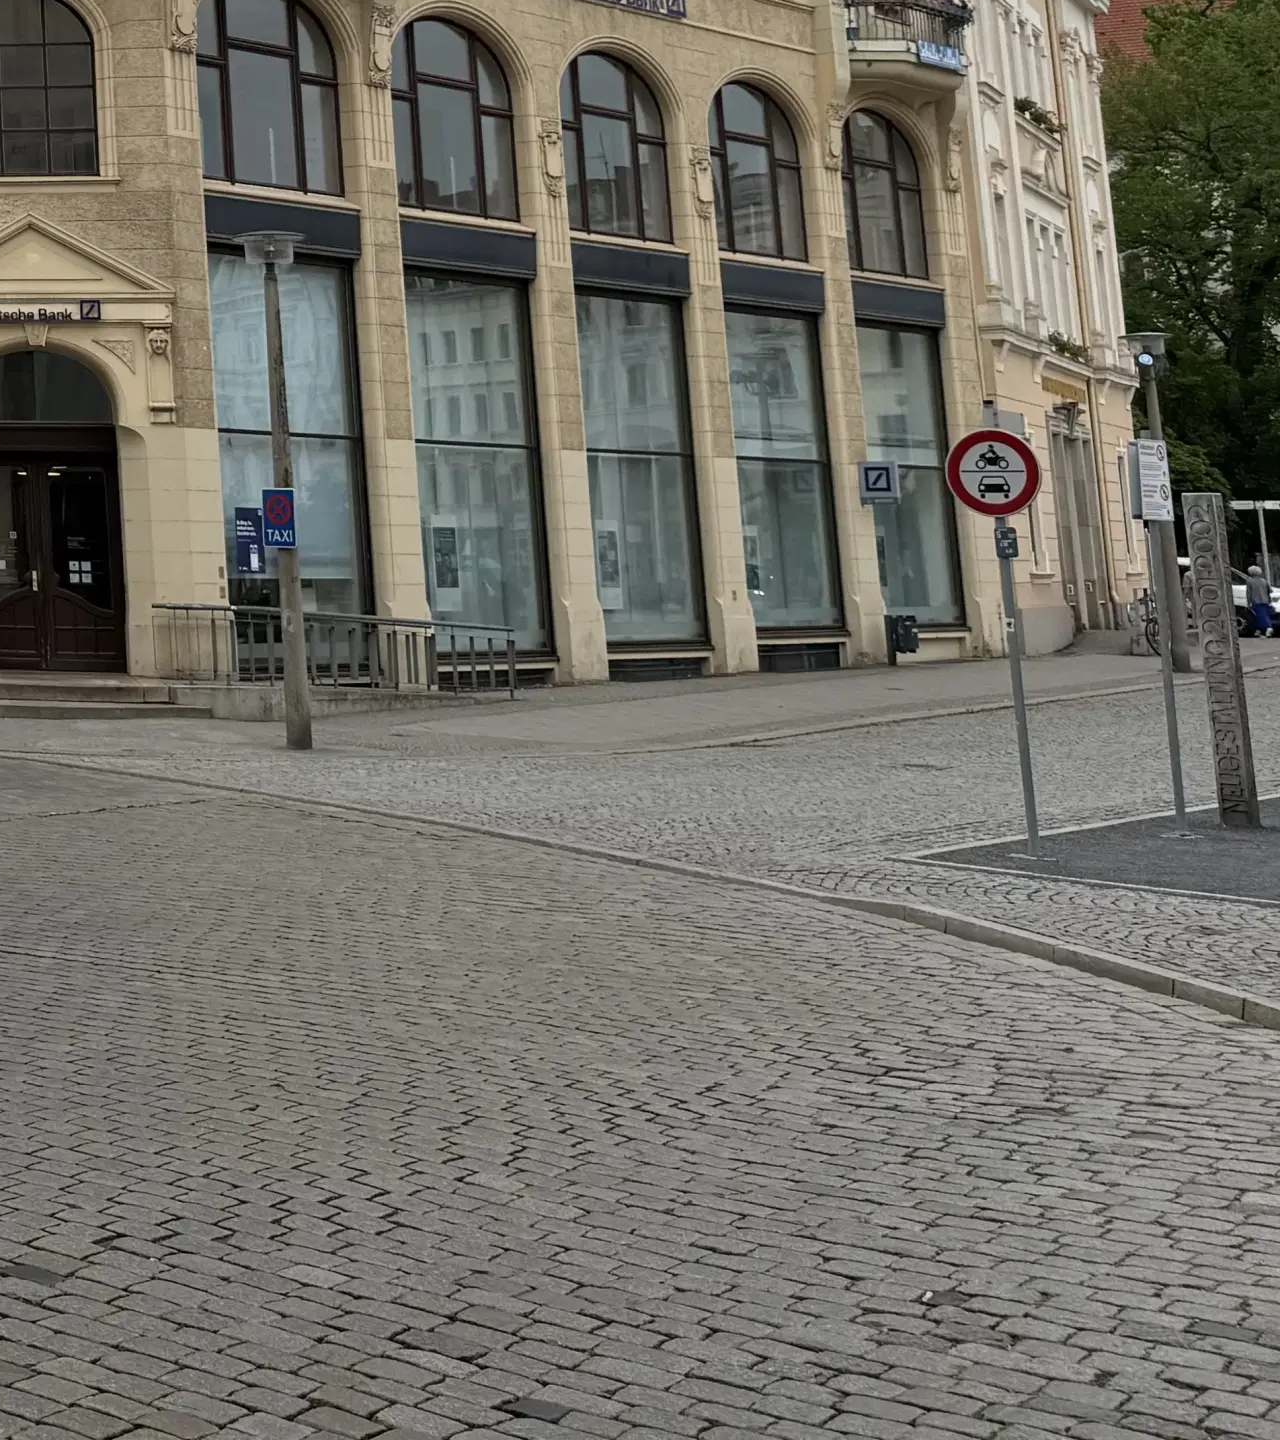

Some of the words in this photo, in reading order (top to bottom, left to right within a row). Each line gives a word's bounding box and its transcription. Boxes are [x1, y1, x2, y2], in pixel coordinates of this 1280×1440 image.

[37, 307, 73, 321] Bank
[266, 528, 293, 543] TAXI
[1188, 503, 1227, 636] 2001-2002
[1205, 639, 1247, 816] NEUGESTALTUNG
